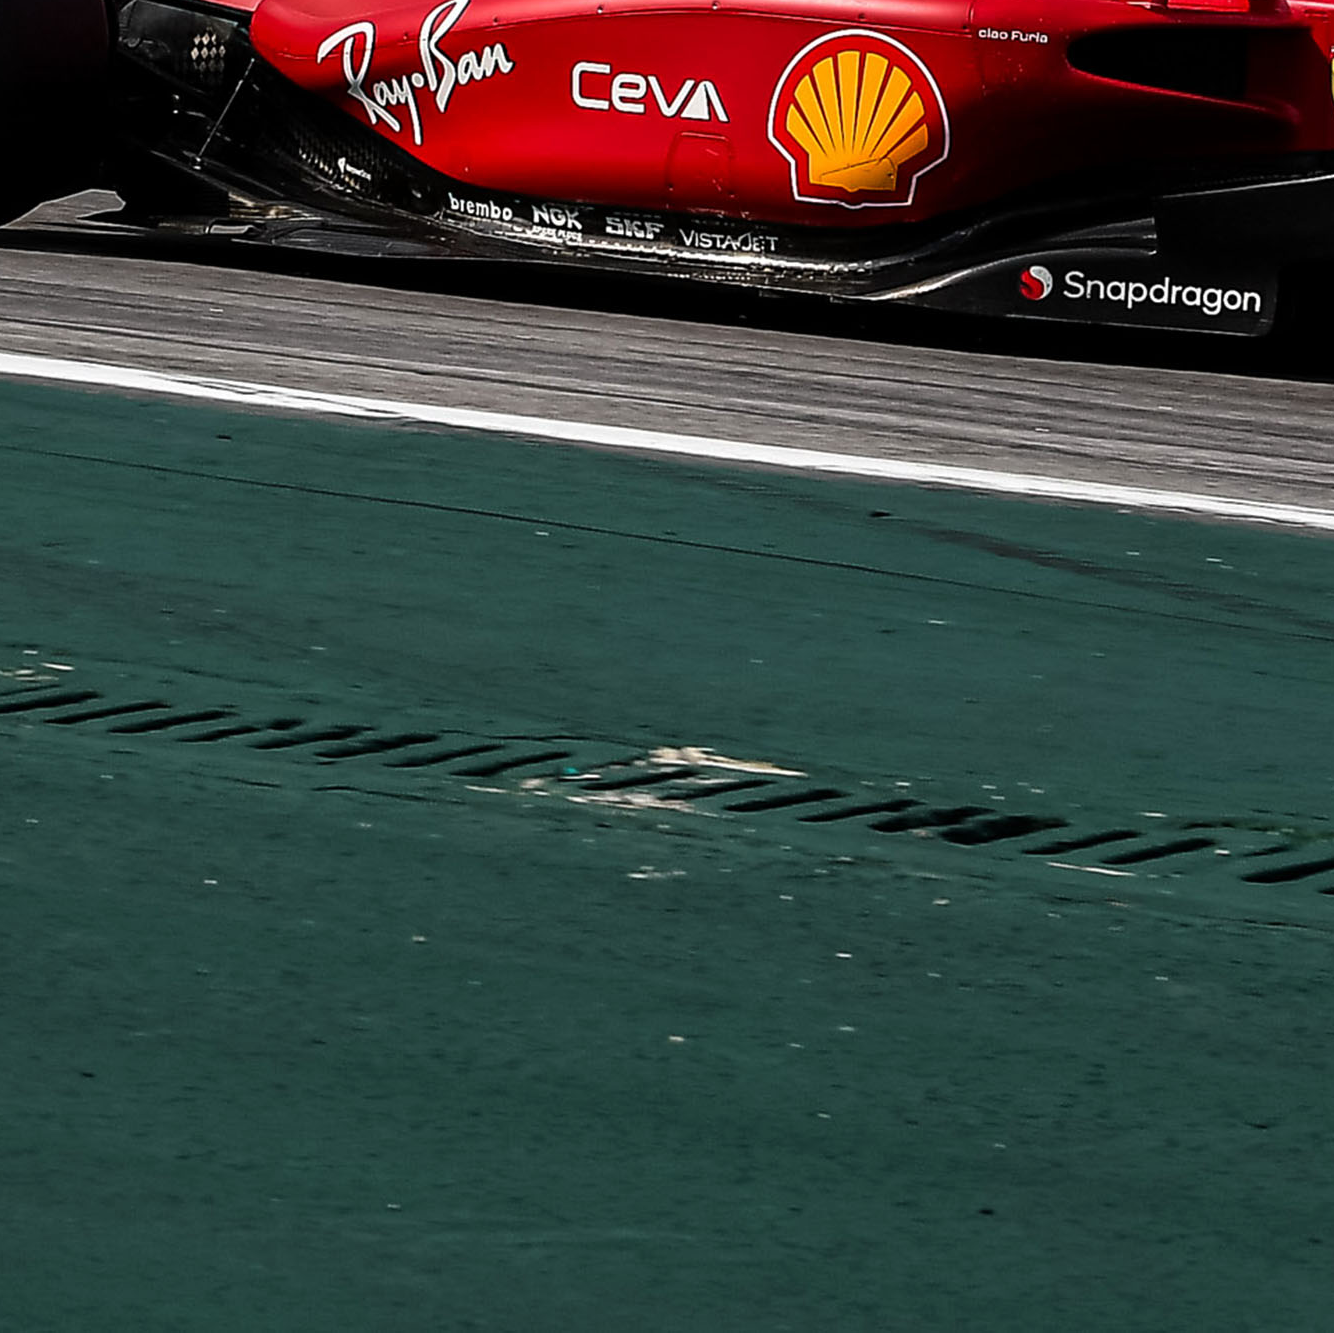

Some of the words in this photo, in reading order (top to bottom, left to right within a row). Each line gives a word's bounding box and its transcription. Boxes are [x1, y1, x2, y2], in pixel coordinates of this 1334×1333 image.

[448, 192, 513, 222] brembo
[531, 204, 583, 231] NGK
[605, 215, 664, 240] SKF
[1063, 270, 1262, 315] Snapdragon
